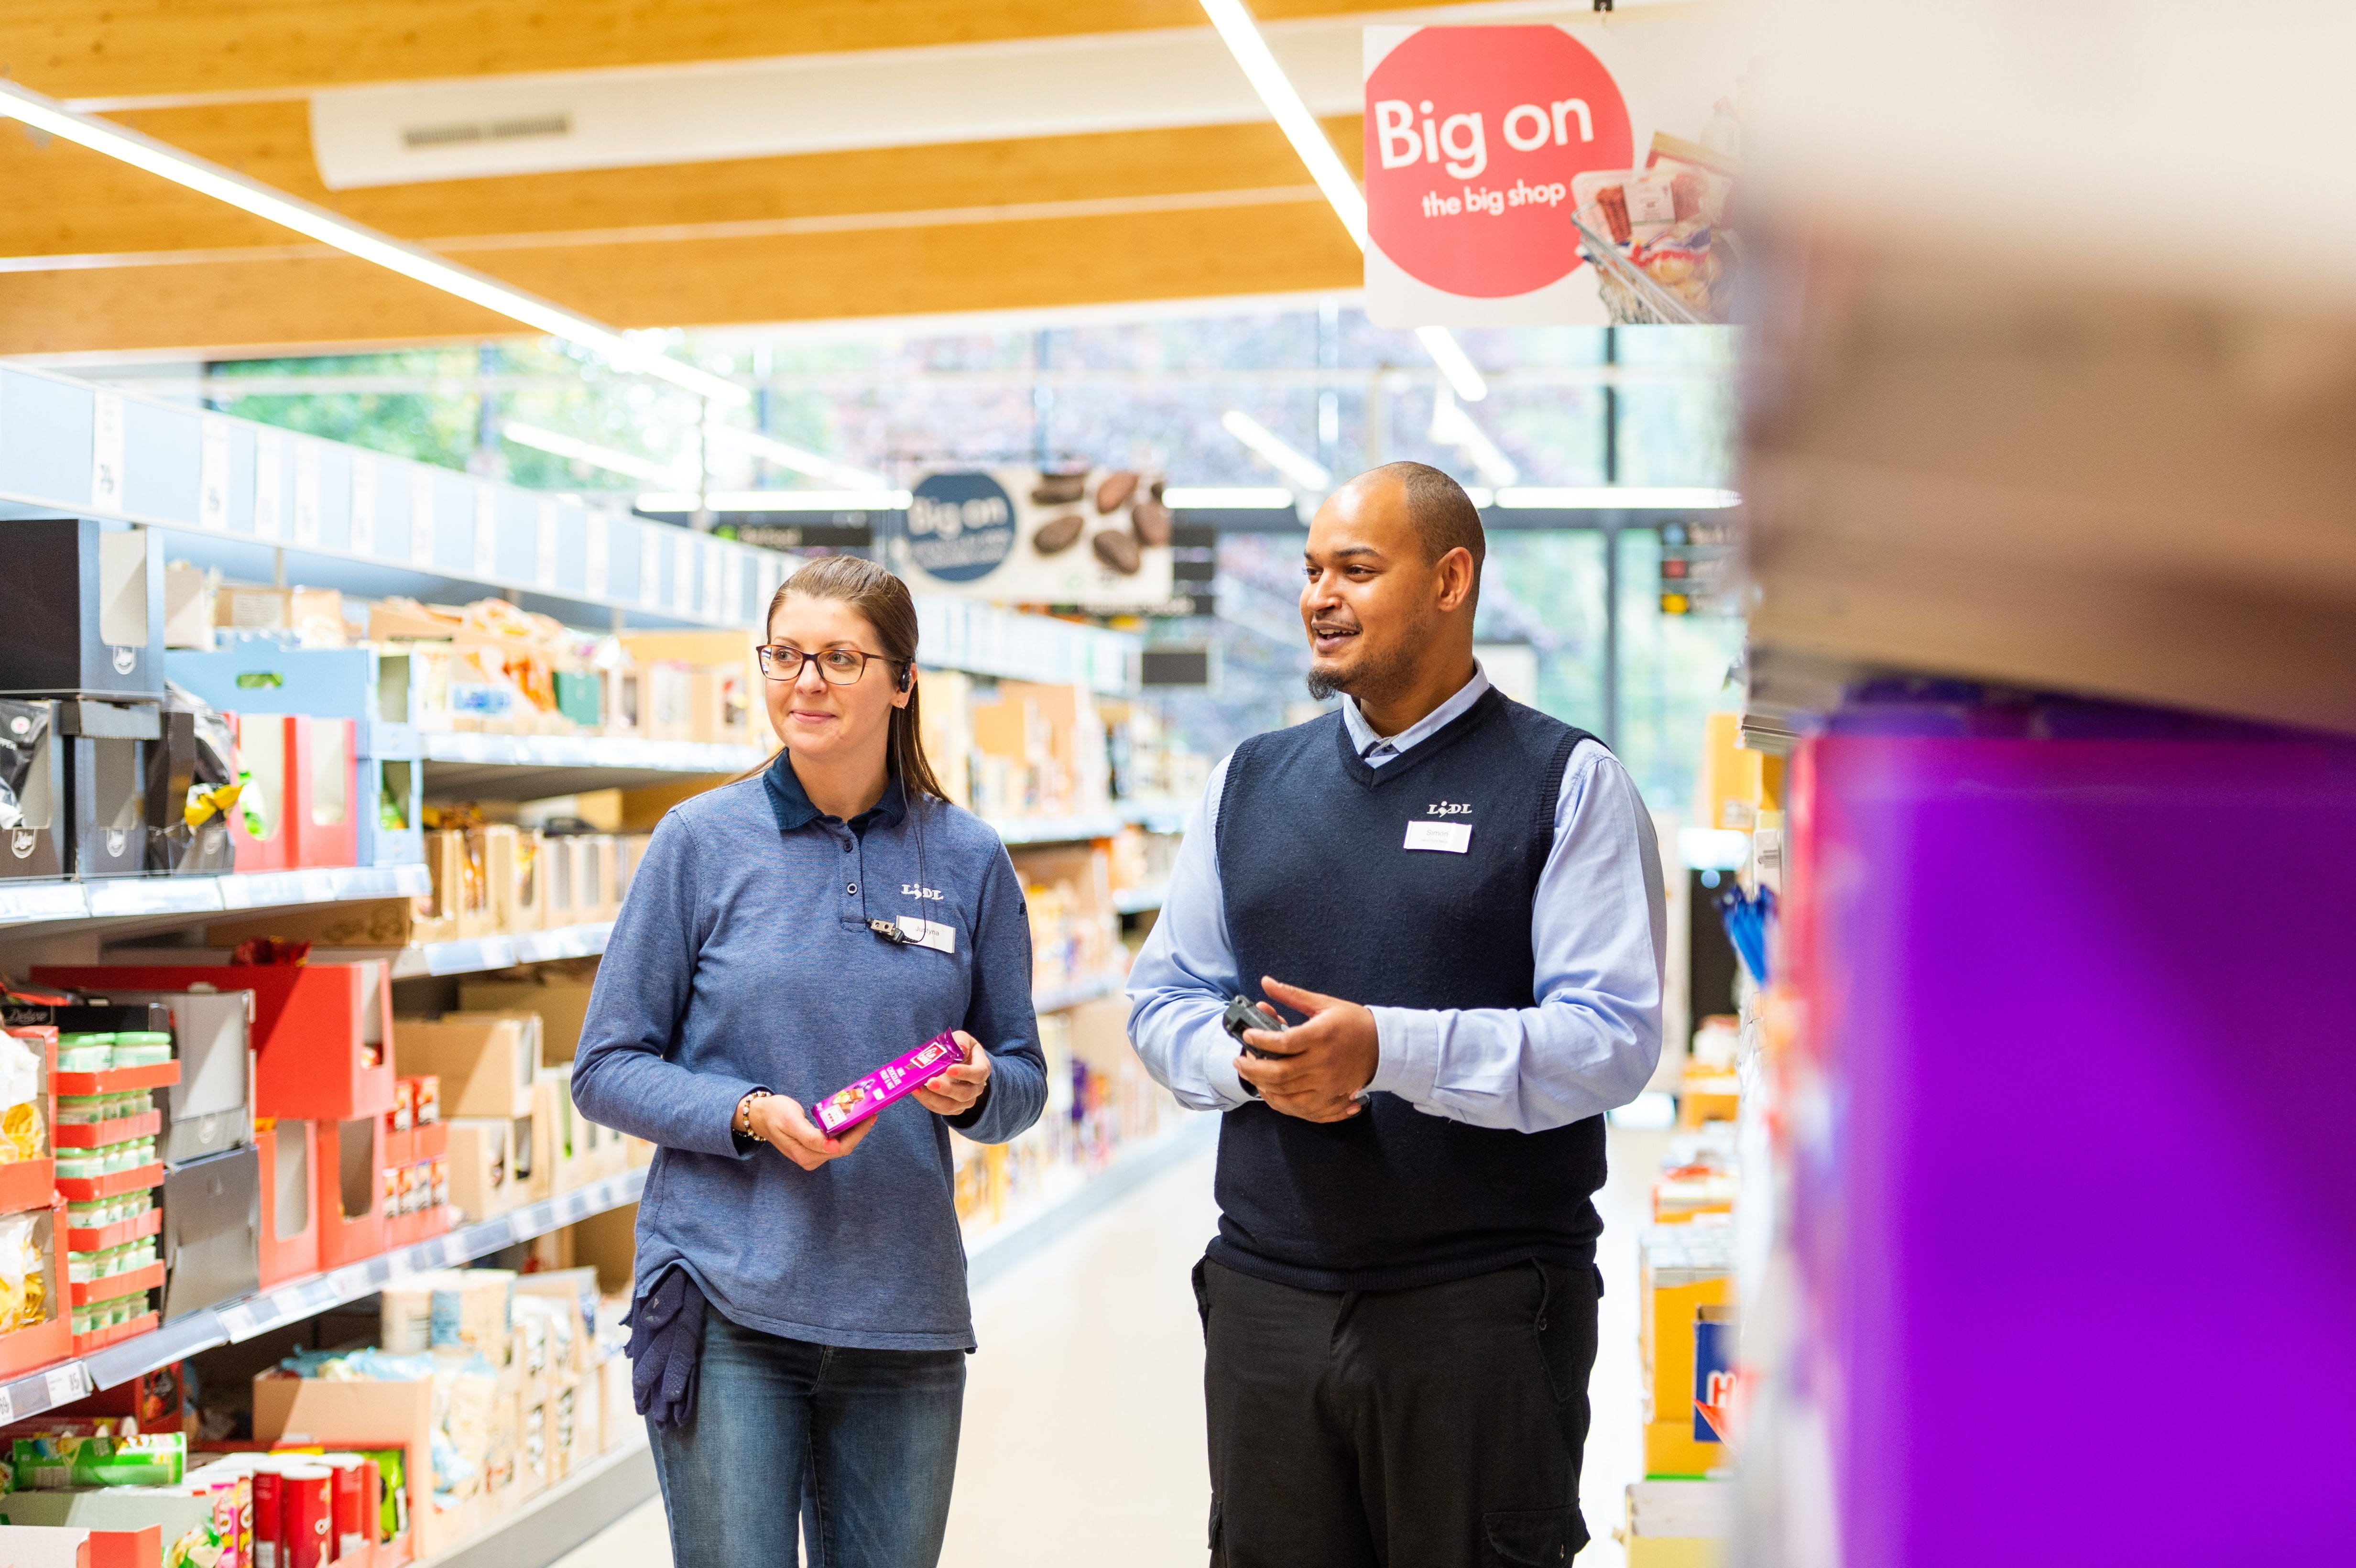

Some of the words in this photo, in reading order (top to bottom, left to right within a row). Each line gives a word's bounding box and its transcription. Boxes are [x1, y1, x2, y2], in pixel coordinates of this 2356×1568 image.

[1374, 99, 1488, 180] Big
[1503, 97, 1595, 152] on
[1421, 190, 1462, 218] the
[1463, 185, 1505, 216] big
[1507, 179, 1567, 207] shop
[887, 1067, 902, 1086] CHOCOLATE
